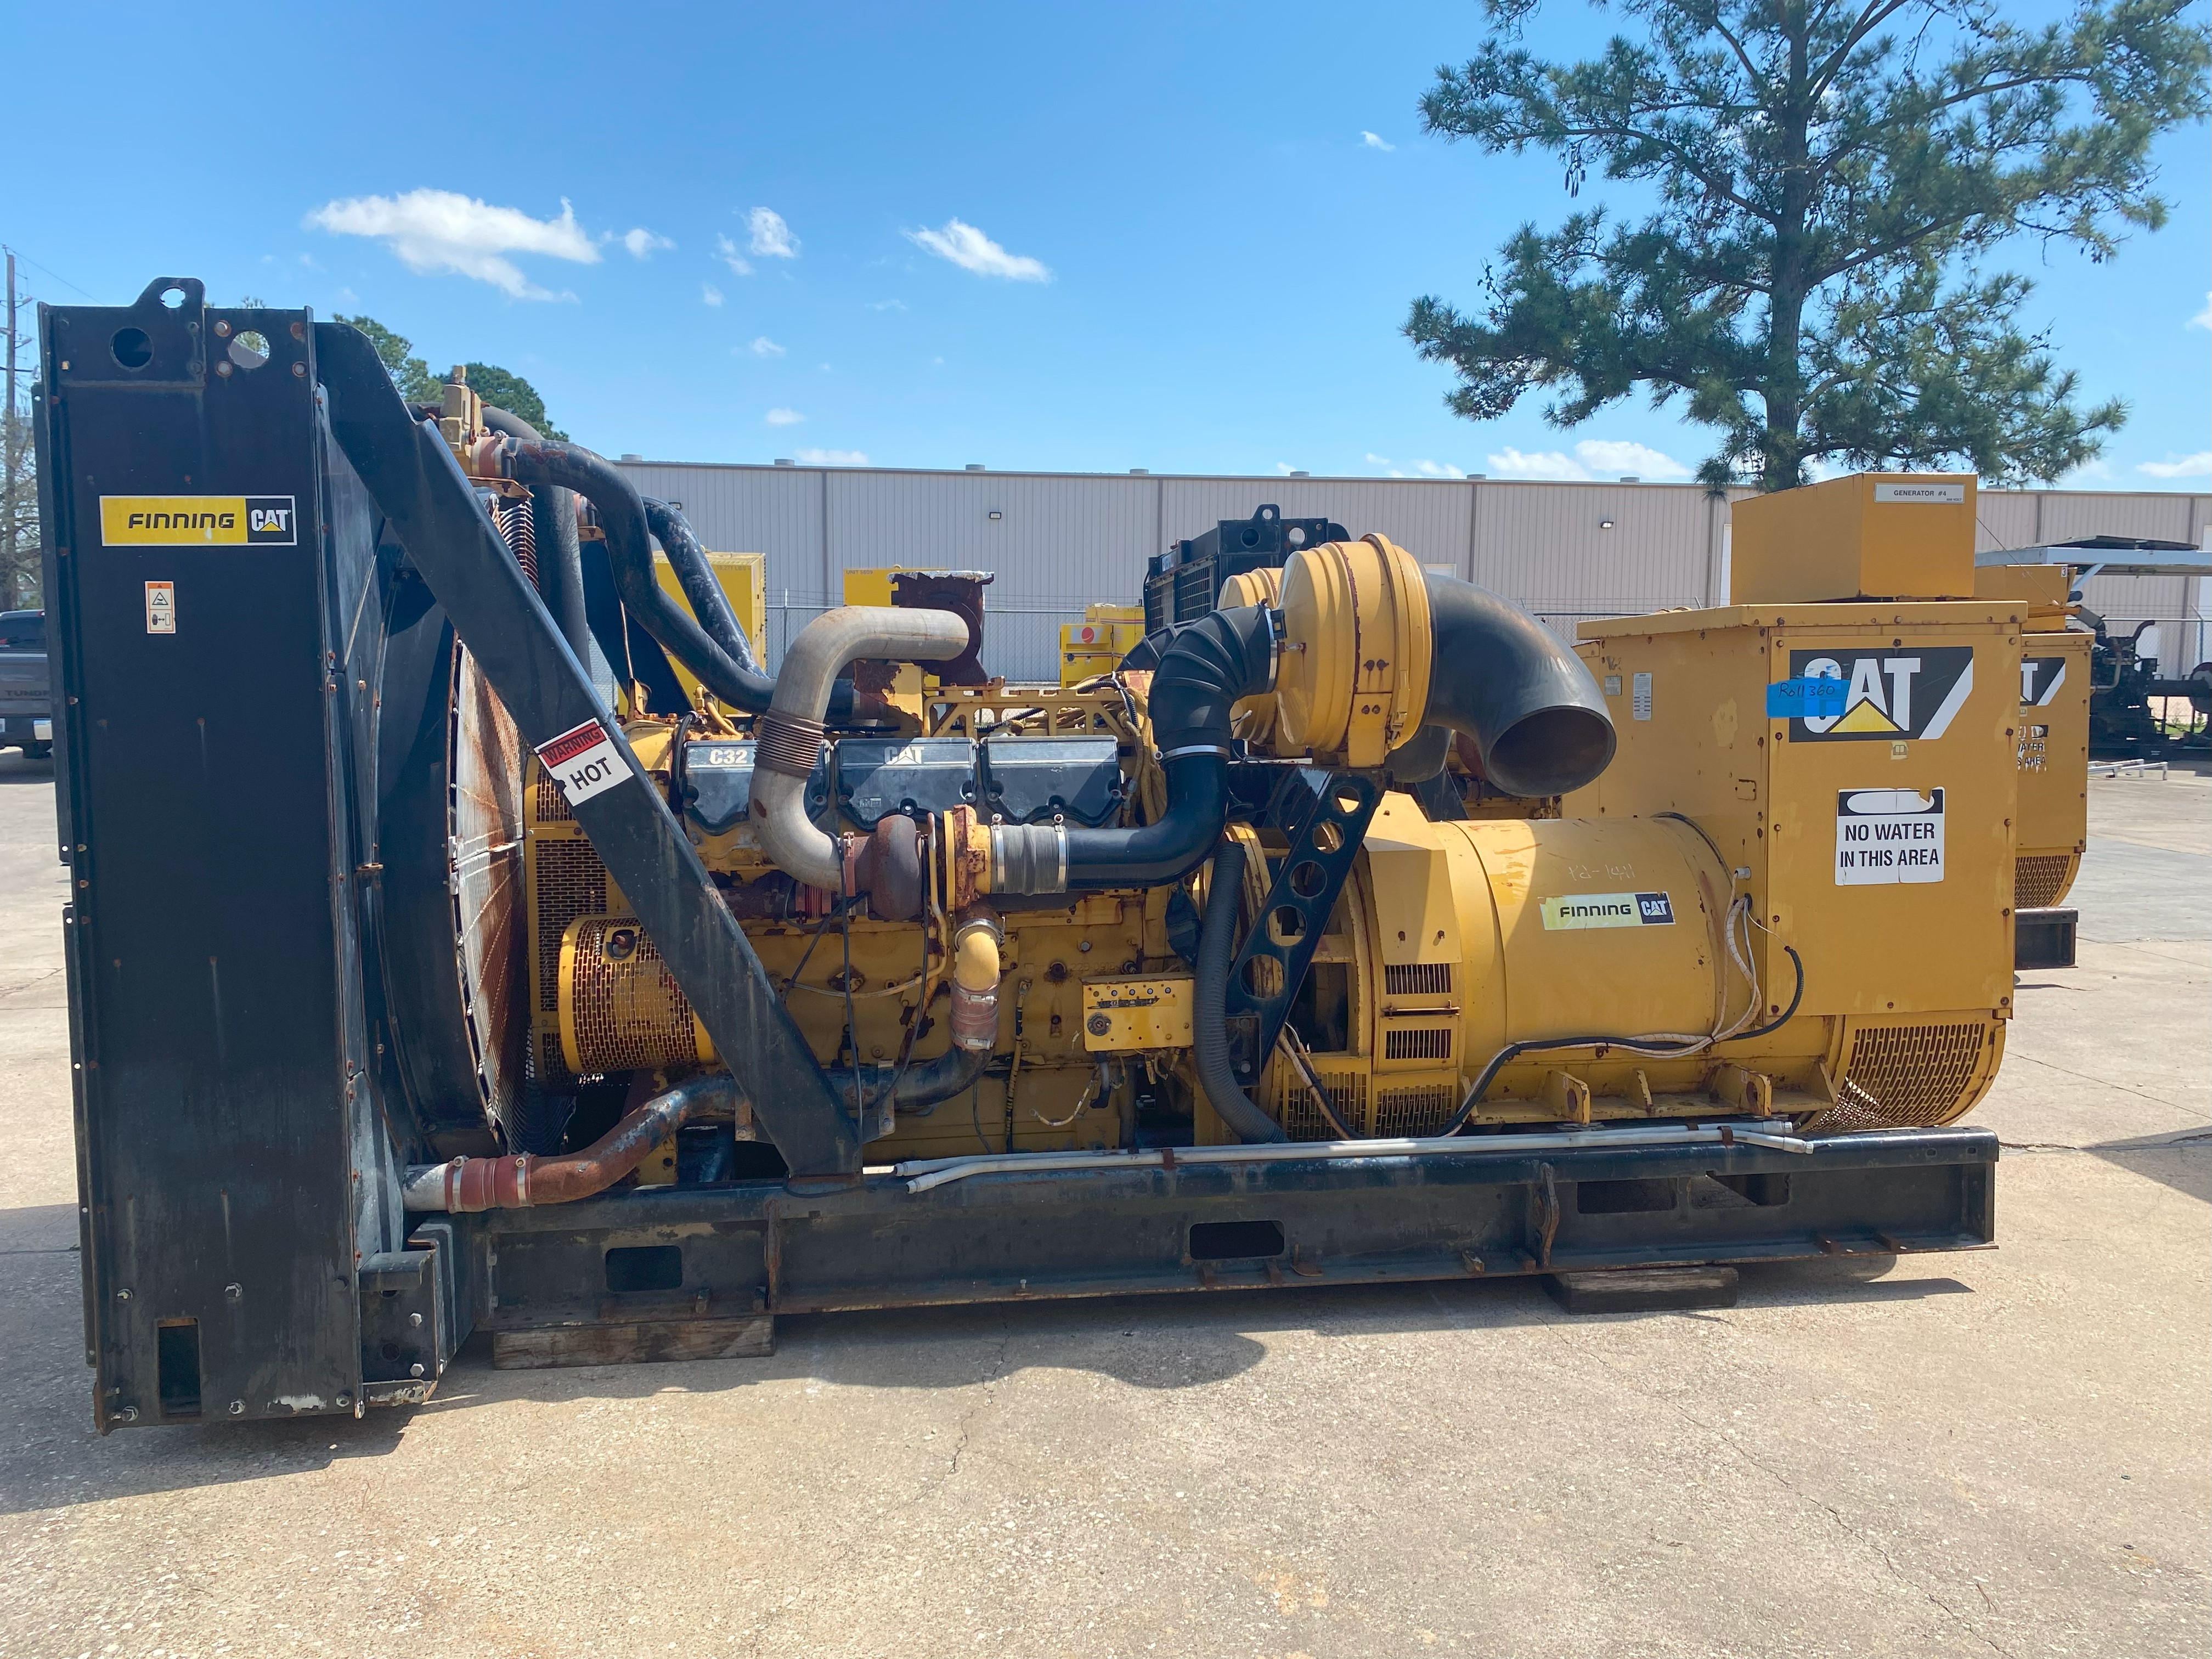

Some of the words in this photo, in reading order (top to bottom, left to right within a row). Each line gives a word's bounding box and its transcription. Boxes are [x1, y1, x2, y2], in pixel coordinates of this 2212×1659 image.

[128, 513, 235, 529] FINNING
[251, 509, 289, 532] CAT
[2062, 567, 2066, 576] 3
[1778, 682, 1805, 698] Roll
[1809, 685, 1835, 696] 360
[544, 727, 601, 763] WARNING
[2018, 743, 2044, 752] ATER
[709, 749, 748, 765] C32
[884, 746, 925, 765] CAT
[569, 757, 612, 791] HOT
[1845, 824, 1869, 842] NO
[1875, 822, 1935, 840] WATER
[1840, 851, 1854, 867] IN
[1859, 849, 1893, 867] THIS
[1897, 848, 1939, 866] AREA
[1560, 904, 1632, 918] FINNING
[1640, 900, 1667, 916] CAT
